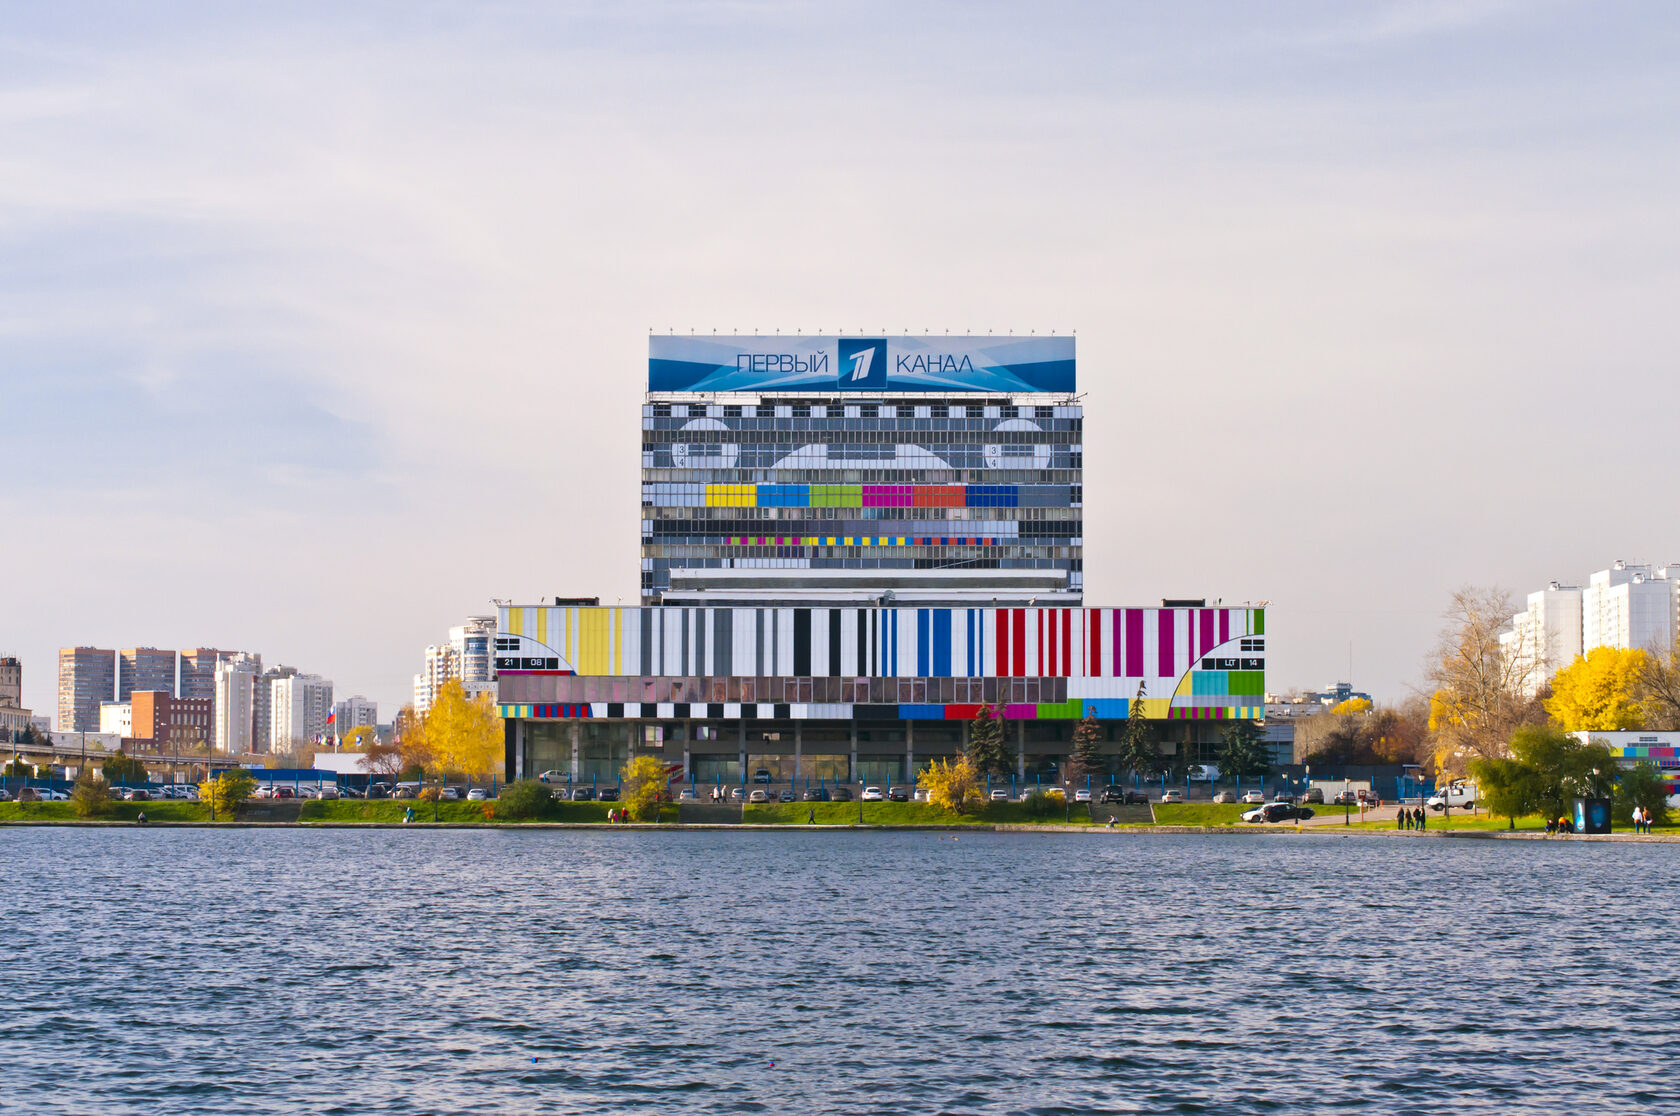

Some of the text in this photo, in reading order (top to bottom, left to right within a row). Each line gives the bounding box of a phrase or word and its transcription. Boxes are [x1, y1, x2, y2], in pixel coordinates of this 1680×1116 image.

[737, 350, 828, 373] ПЕРВЫЙ
[896, 354, 974, 373] КАНАЛ
[1224, 659, 1236, 667] ЦТ
